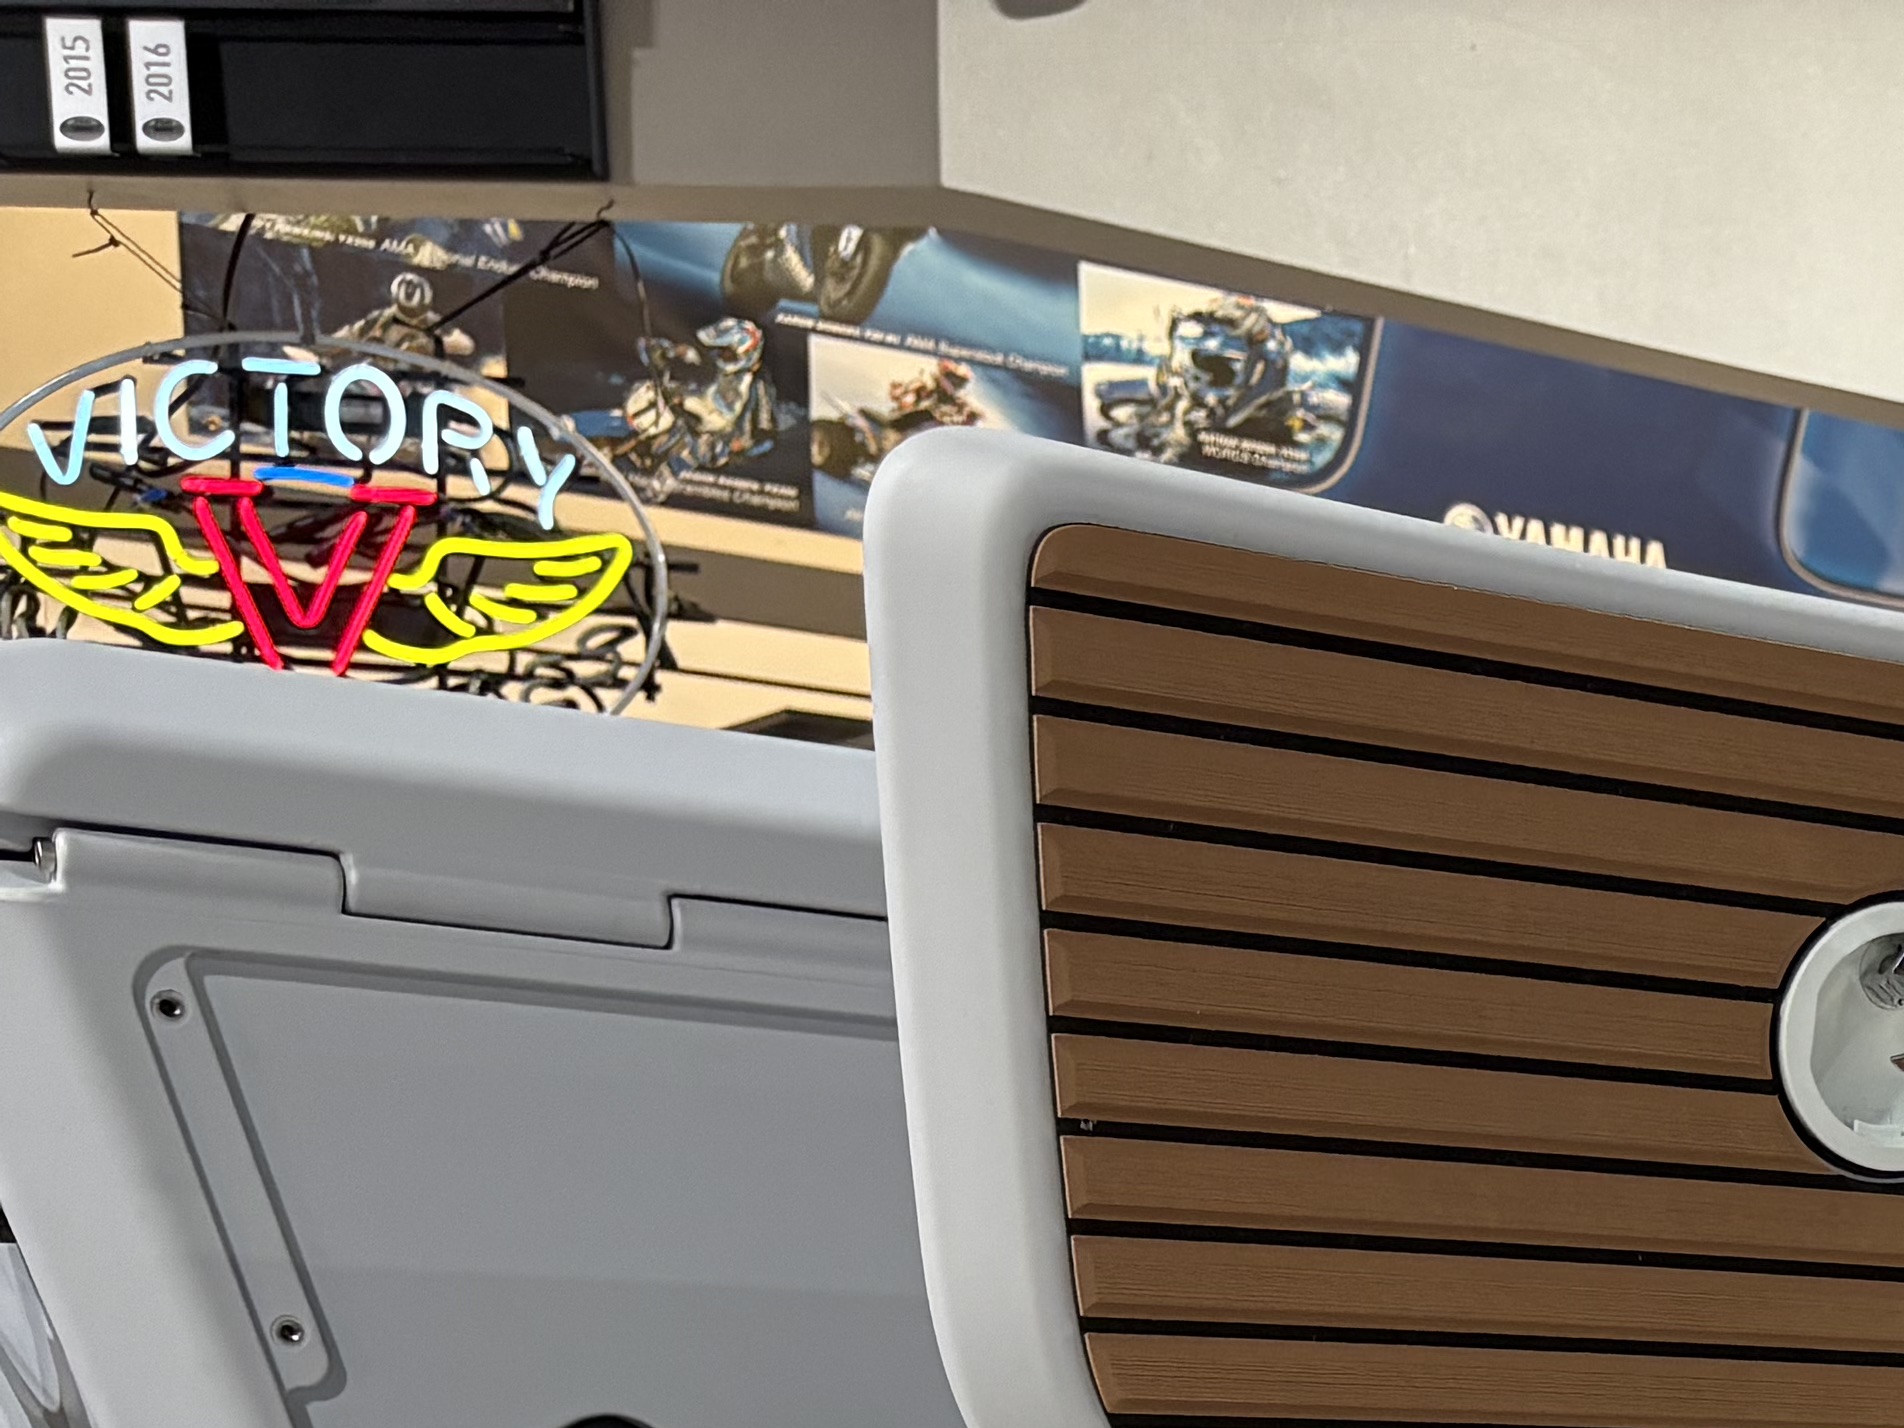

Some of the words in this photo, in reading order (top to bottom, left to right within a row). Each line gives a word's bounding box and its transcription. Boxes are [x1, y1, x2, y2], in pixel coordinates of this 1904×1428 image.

[61, 35, 93, 96] 2015
[143, 43, 173, 103] 2016
[28, 357, 576, 530] VICTORY
